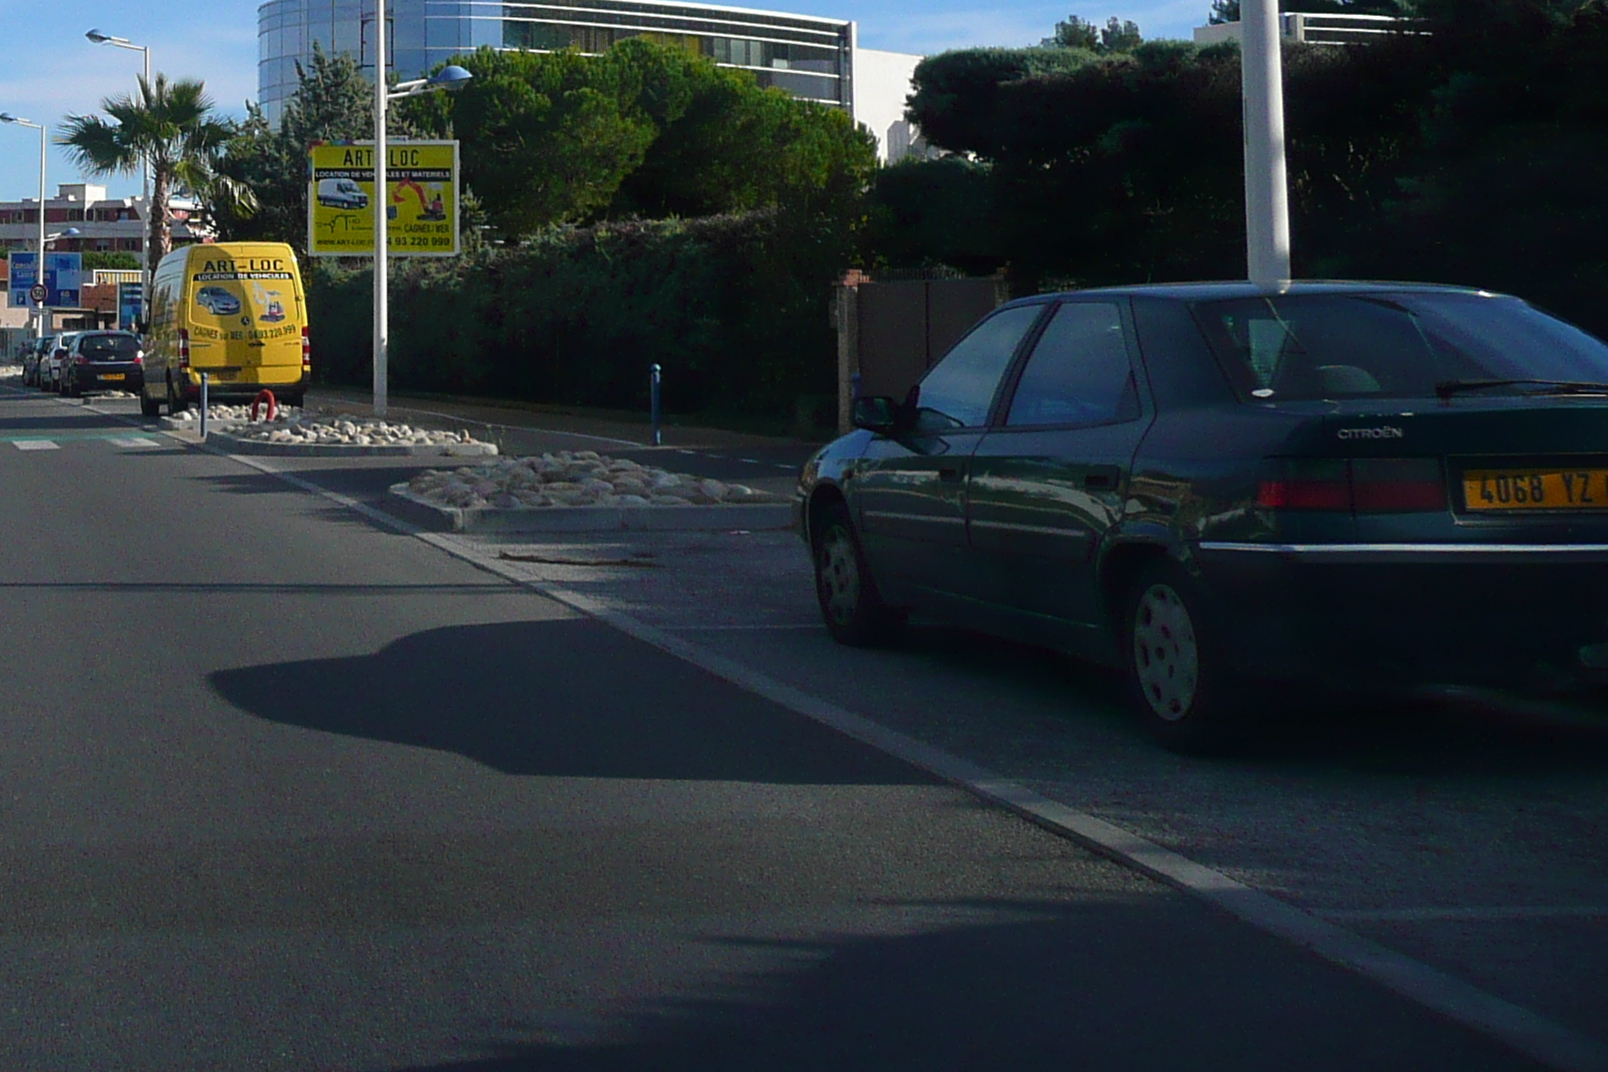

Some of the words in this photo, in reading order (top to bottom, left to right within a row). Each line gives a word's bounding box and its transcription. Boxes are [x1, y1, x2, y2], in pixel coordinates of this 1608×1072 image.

[315, 170, 349, 178] LOCATION
[412, 170, 450, 178] MATERIELS
[395, 237, 407, 246] 93
[410, 237, 429, 246] 220
[431, 237, 450, 246] 999
[1337, 425, 1404, 439] CITROËN
[1479, 475, 1545, 504] 4068
[1560, 473, 1594, 503] YZ
